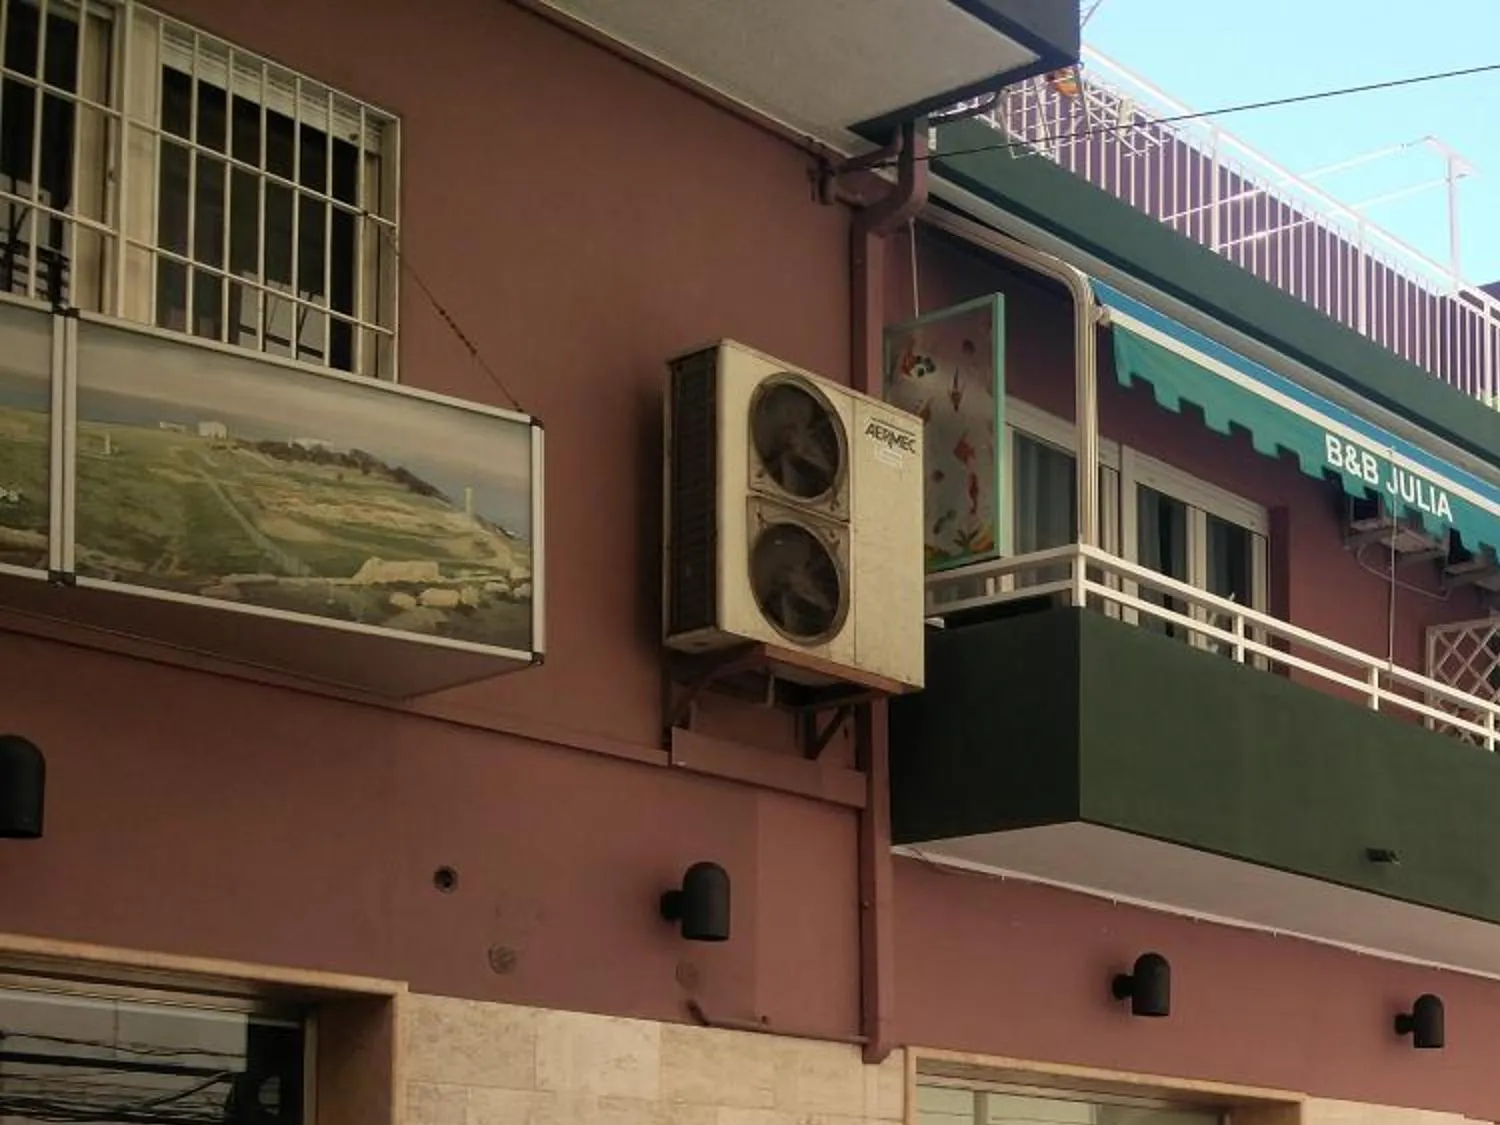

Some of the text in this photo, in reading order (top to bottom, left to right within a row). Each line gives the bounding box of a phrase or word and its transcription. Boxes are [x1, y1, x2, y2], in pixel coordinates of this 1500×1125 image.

[865, 423, 917, 454] AERMEC
[1325, 433, 1453, 523] B&B JULIA
